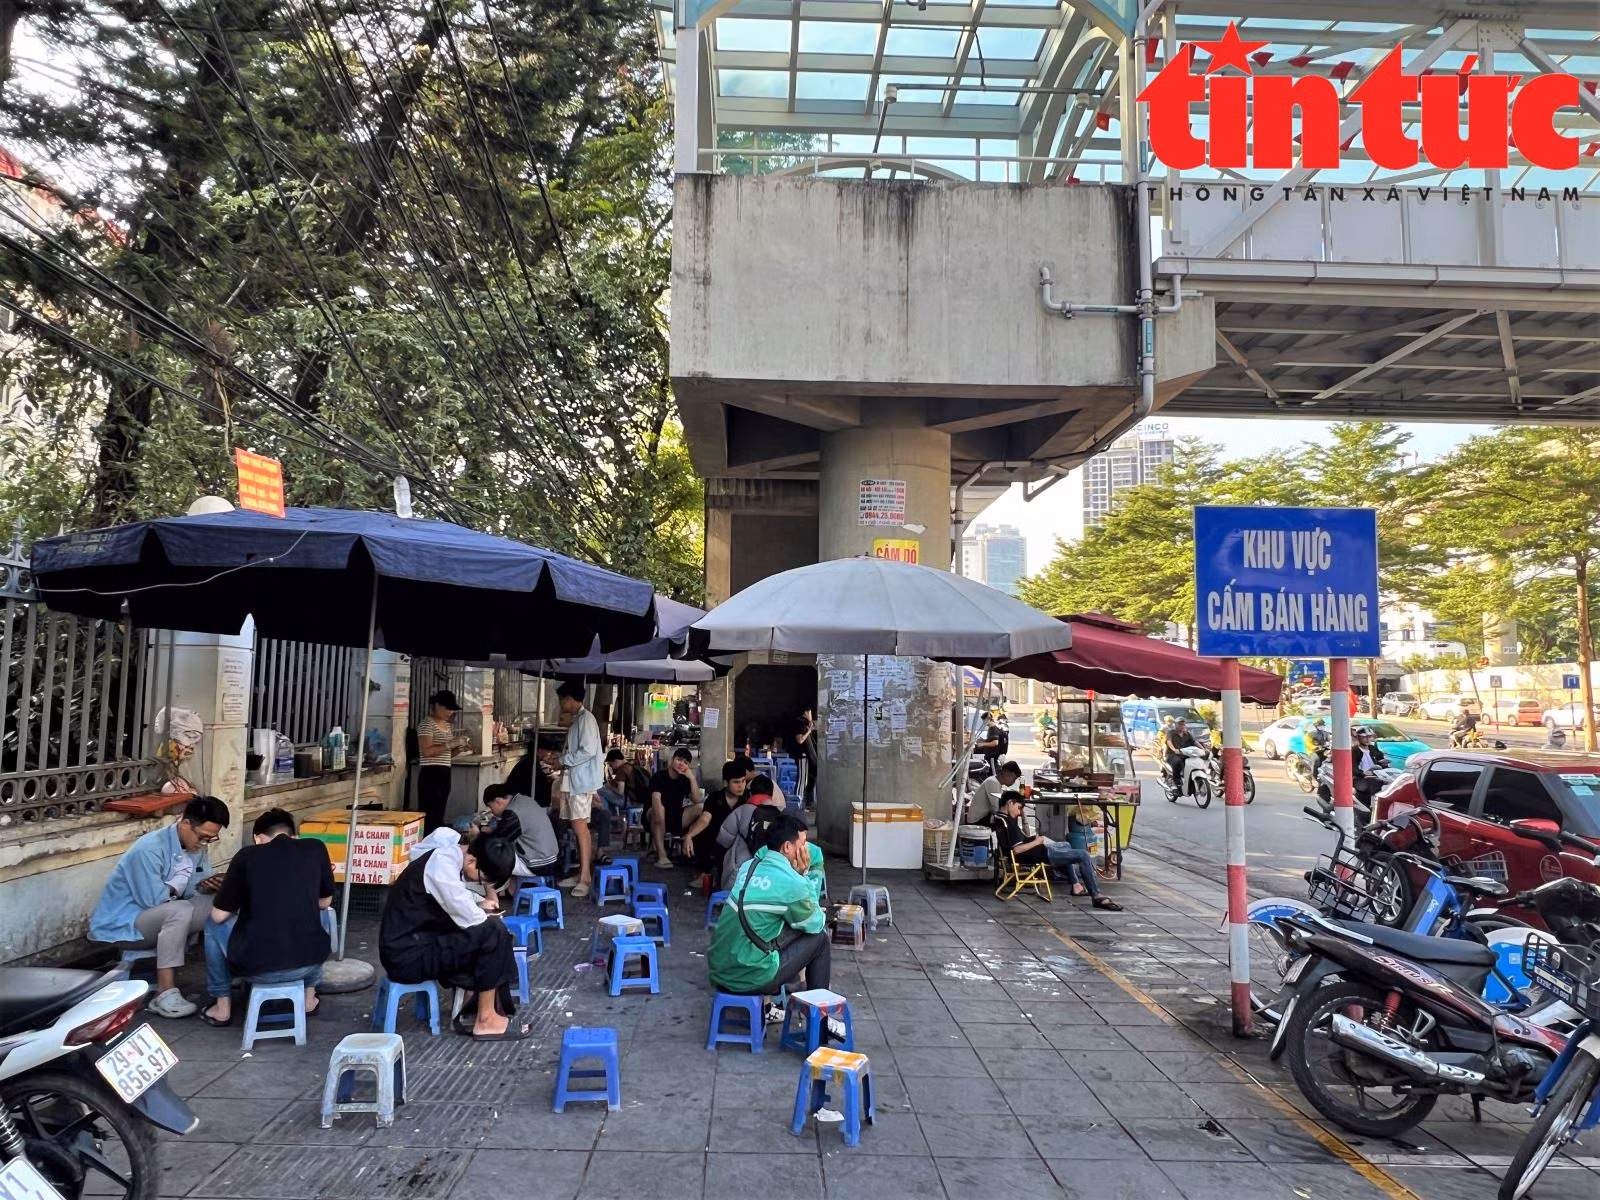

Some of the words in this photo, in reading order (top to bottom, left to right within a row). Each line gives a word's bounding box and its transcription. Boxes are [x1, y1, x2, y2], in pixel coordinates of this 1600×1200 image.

[1243, 529, 1285, 570] KHU
[1291, 526, 1332, 576] VỰC
[1207, 579, 1255, 632] CẤM
[1260, 586, 1307, 633] BÁN
[1310, 586, 1371, 633] HÀNG
[366, 831, 390, 840] CHANH
[363, 859, 388, 869] CHANH
[117, 1046, 170, 1097] 856.97
